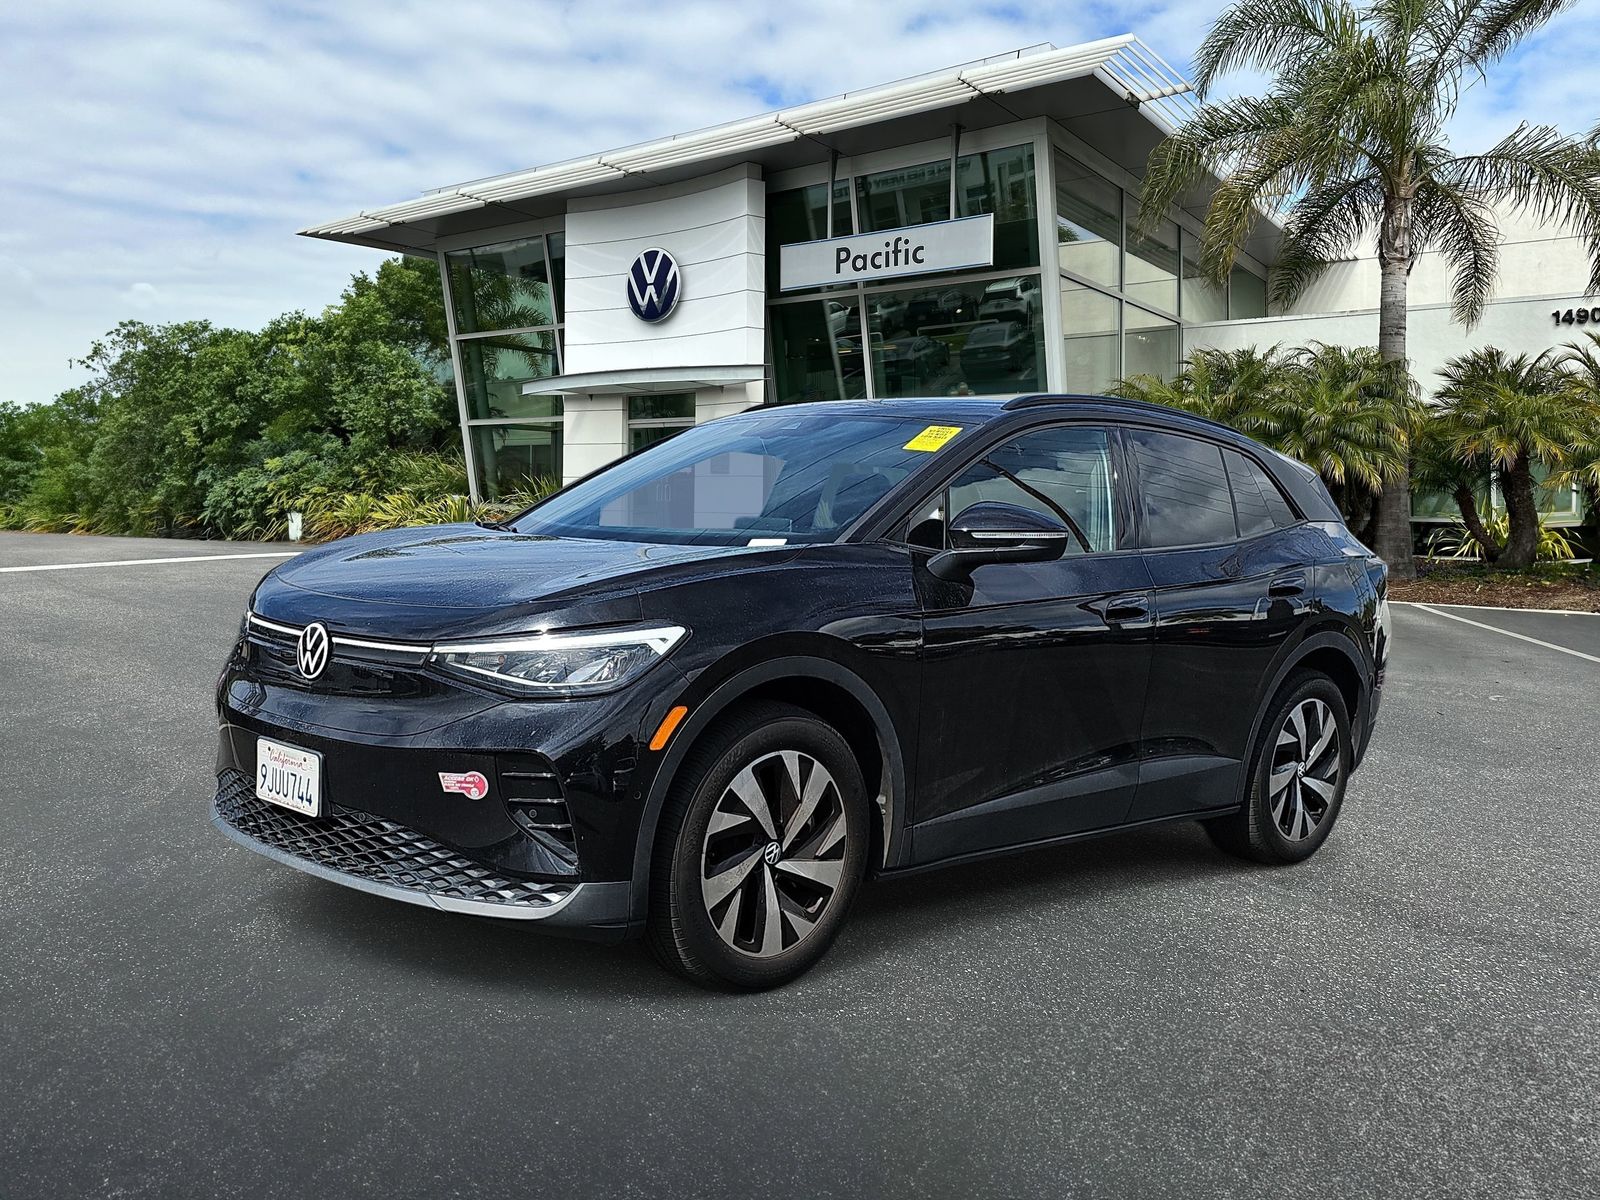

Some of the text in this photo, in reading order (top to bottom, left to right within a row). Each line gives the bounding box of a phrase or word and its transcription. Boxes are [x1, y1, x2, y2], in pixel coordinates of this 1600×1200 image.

[835, 236, 925, 274] Pacific
[626, 248, 680, 321] VW
[1551, 307, 1600, 326] 1490
[298, 624, 327, 677] VW
[269, 748, 307, 771] California
[260, 763, 313, 807] 9JUU744
